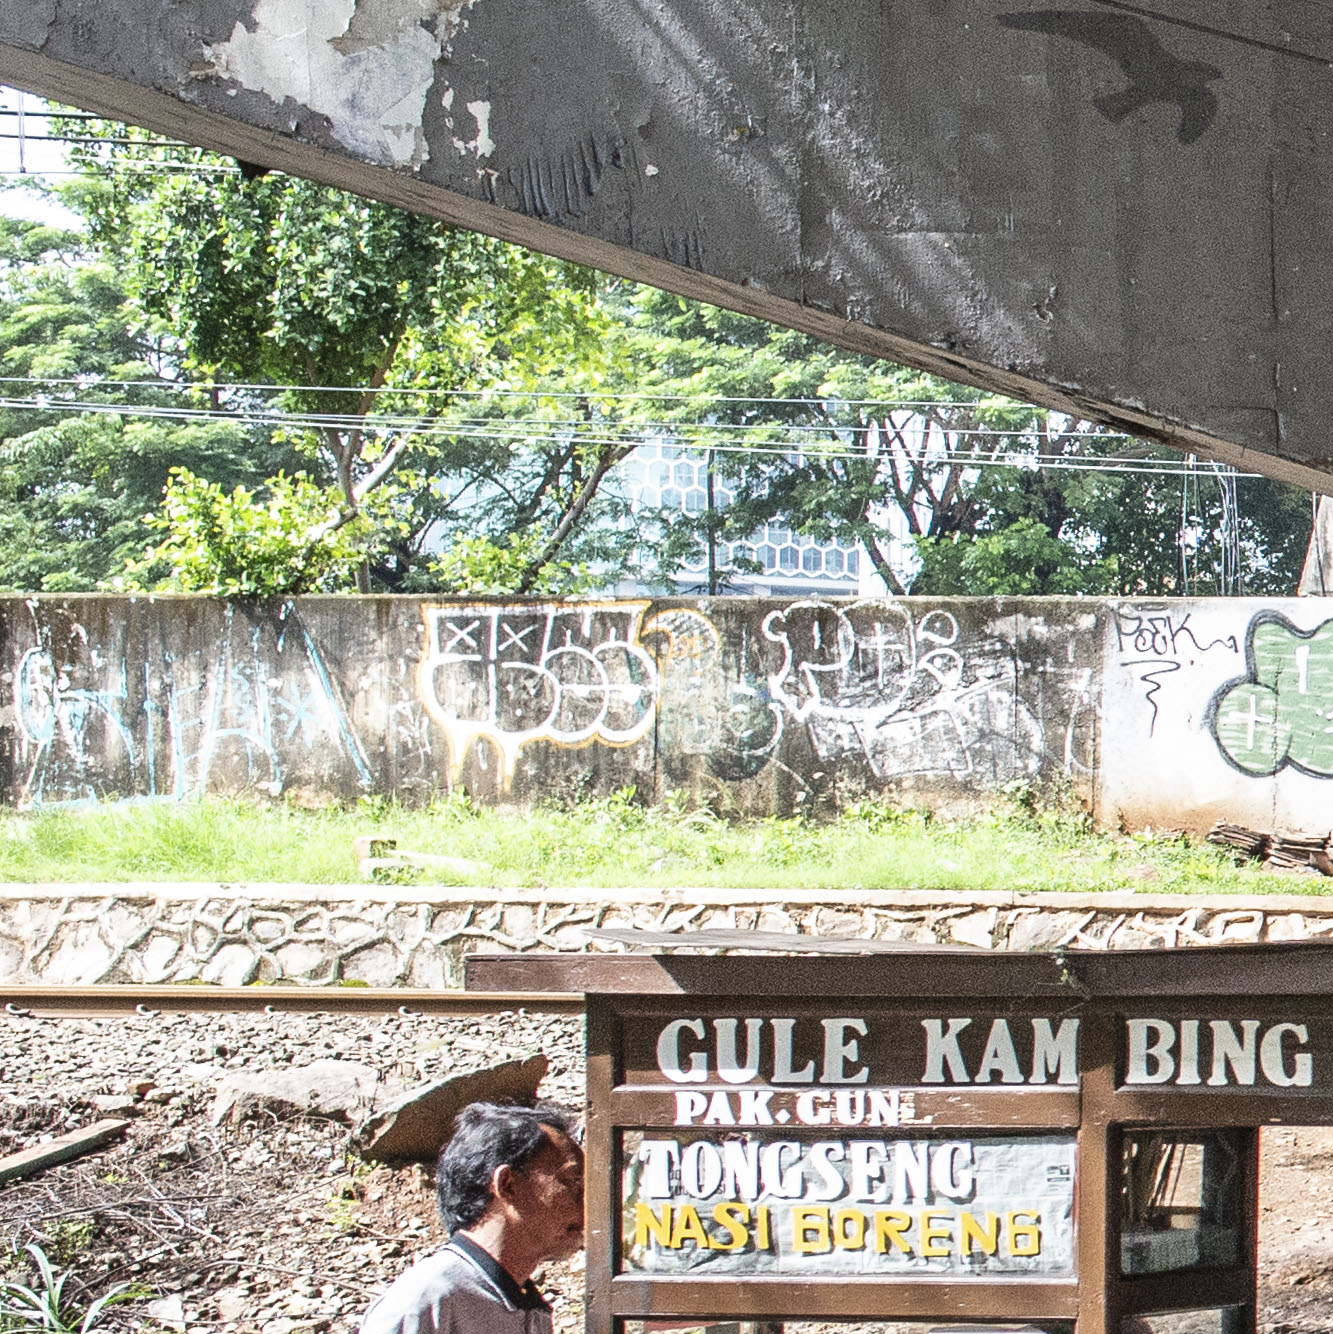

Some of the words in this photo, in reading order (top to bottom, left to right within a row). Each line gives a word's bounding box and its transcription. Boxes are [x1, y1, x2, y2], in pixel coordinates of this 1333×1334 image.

[656, 1018, 869, 1085] GULE
[920, 1018, 1080, 1085] KAM
[1125, 1018, 1313, 1088] BING
[639, 1139, 977, 1204] TONGSENG
[634, 1201, 770, 1251] NASI
